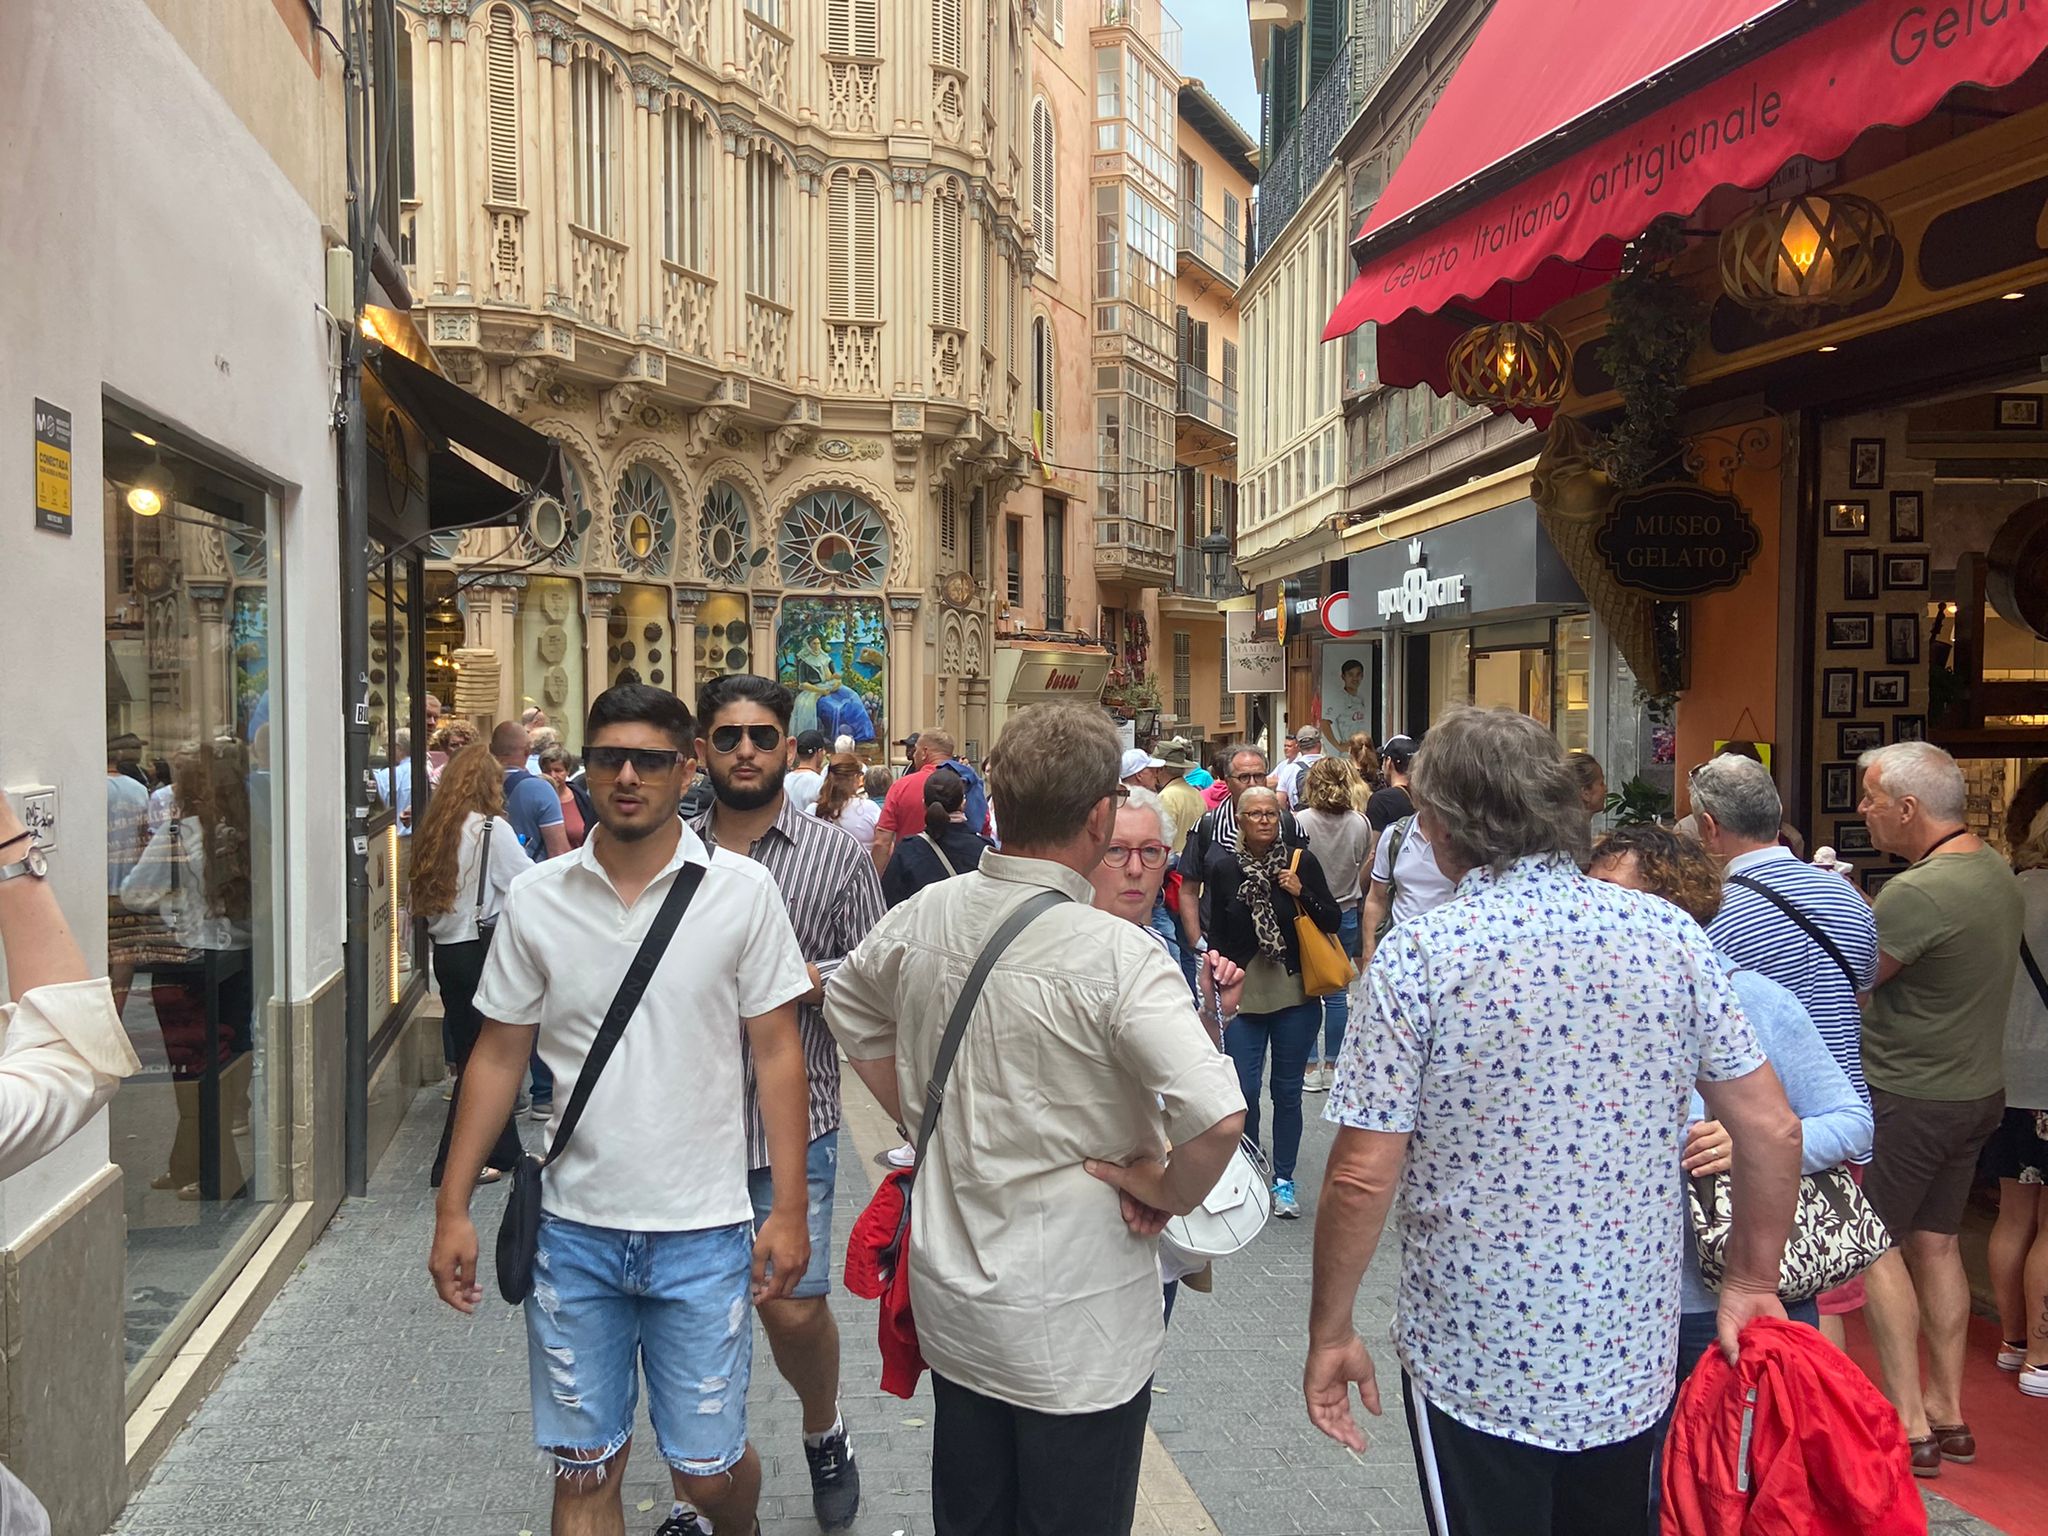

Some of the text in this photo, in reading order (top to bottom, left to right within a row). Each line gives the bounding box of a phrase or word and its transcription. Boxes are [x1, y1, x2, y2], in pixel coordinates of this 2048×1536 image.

[1890, 0, 2026, 65] Gela
[1383, 82, 1783, 294] Gelato Italiano artigianale
[1634, 515, 1721, 536] MUSEO
[1626, 547, 1727, 568] GELATO
